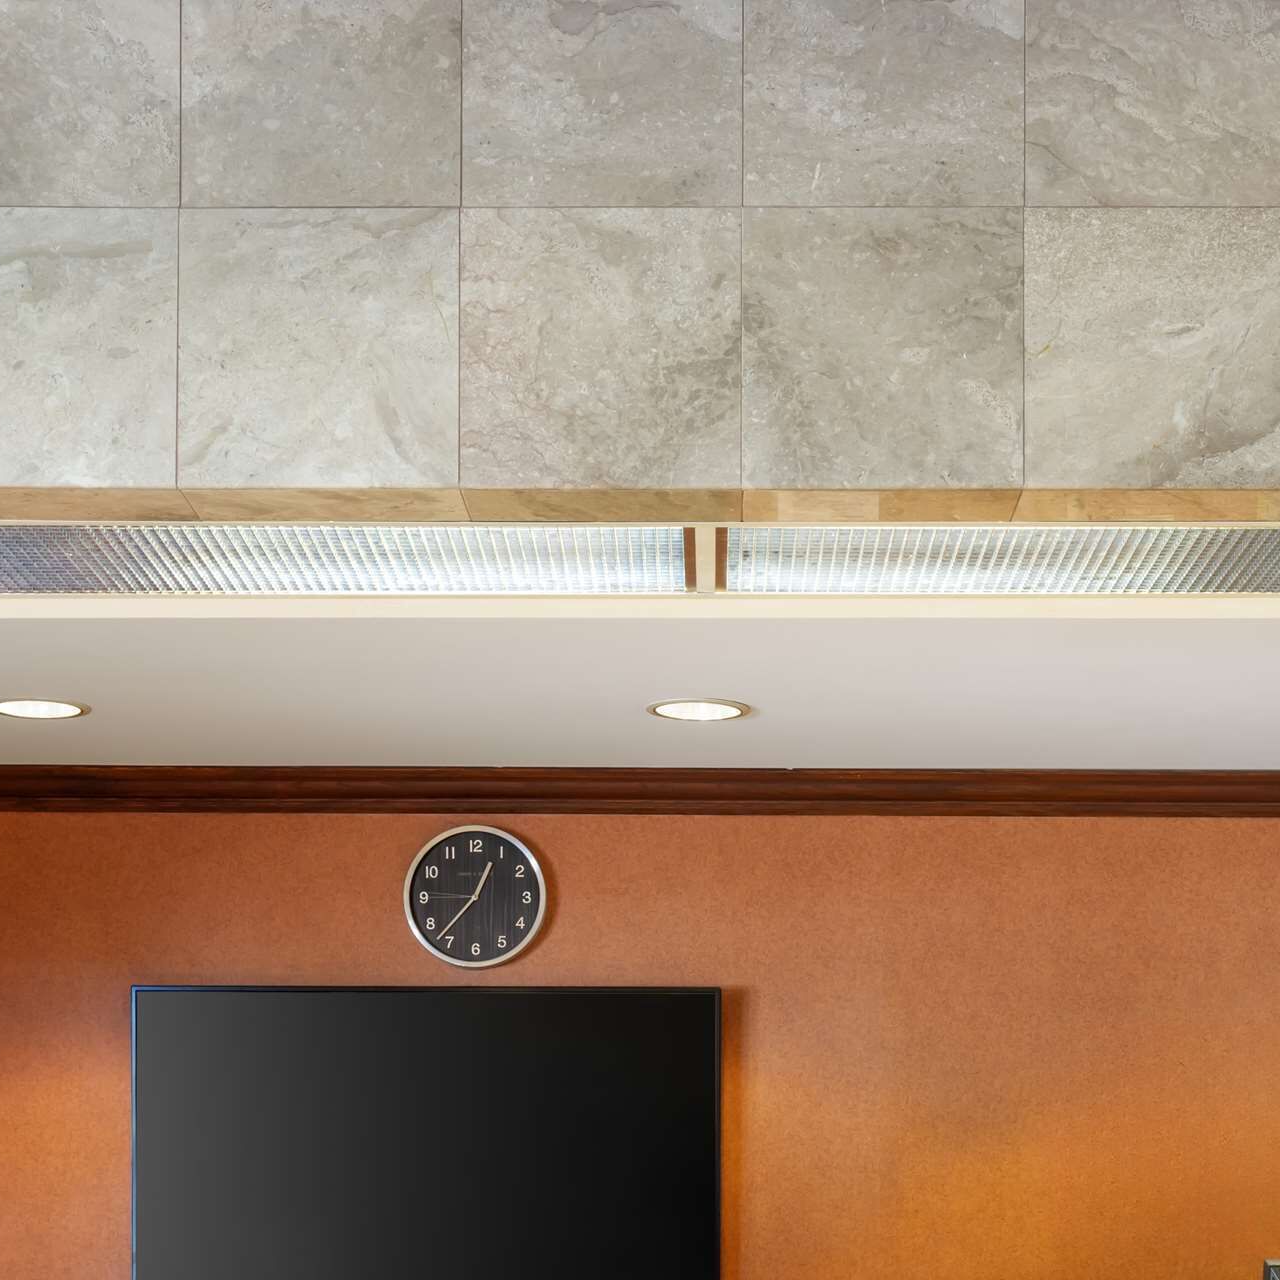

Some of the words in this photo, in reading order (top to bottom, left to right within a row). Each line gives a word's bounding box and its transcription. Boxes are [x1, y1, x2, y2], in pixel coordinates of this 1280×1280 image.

[470, 839, 483, 853] 12
[500, 846, 504, 859] 1
[445, 846, 456, 860] 11
[425, 865, 439, 879] 10
[515, 865, 525, 878] 2
[419, 891, 429, 904] 9
[522, 891, 532, 904] 3
[426, 917, 436, 930] 8
[515, 916, 526, 929] 4
[445, 936, 455, 949] 7
[497, 935, 507, 948] 5
[471, 943, 481, 956] 6
